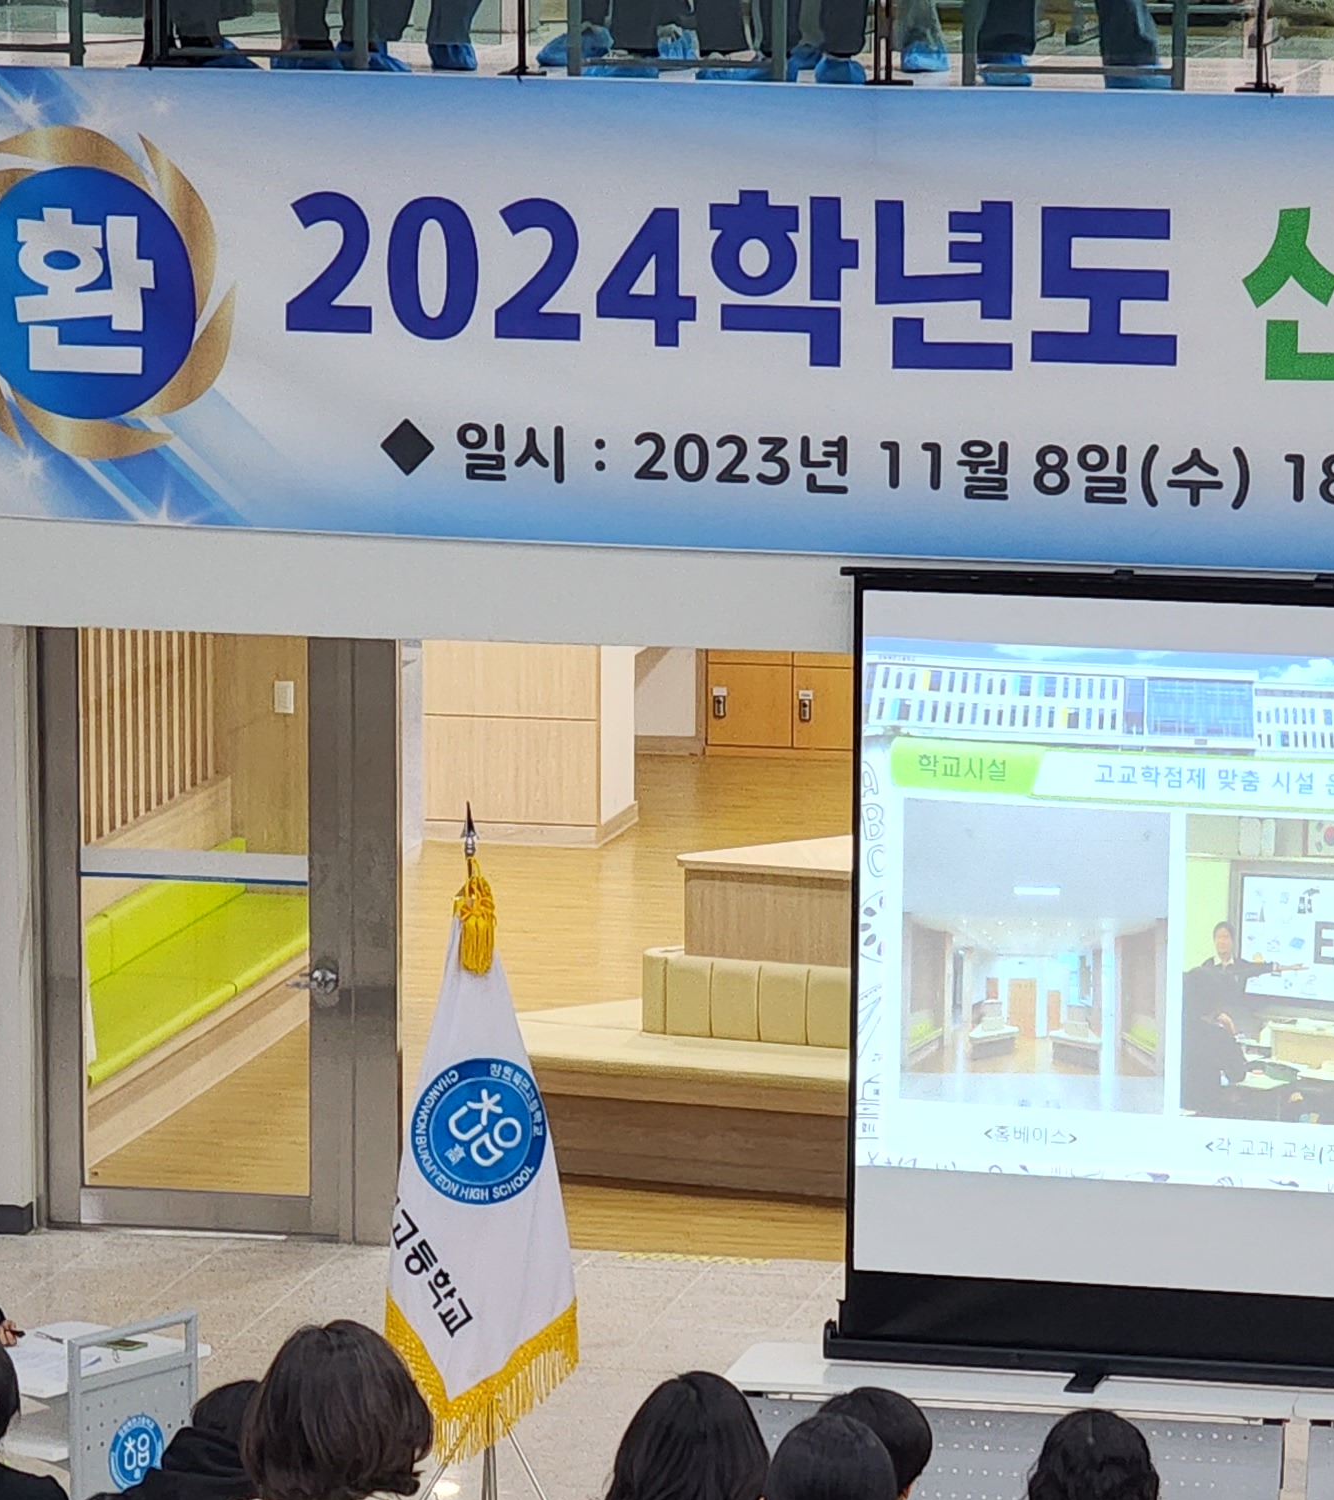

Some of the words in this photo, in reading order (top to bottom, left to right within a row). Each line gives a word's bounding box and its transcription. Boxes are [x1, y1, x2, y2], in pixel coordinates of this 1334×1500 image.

[15, 207, 155, 375] 환
[285, 190, 1178, 371] 2024학년도
[456, 422, 565, 484] 일시
[634, 431, 849, 495] 2023년
[880, 439, 1009, 501] 11월
[1033, 444, 1250, 510] 8일(수)
[917, 753, 1008, 783] 학교시설
[1093, 763, 1207, 791] 고교학점제
[1216, 769, 1261, 793] 맞춤
[1272, 770, 1315, 794] 시설
[458, 1184, 490, 1201] HIGH
[491, 1165, 535, 1200] SCHOOL
[392, 1197, 474, 1339] 고등학교
